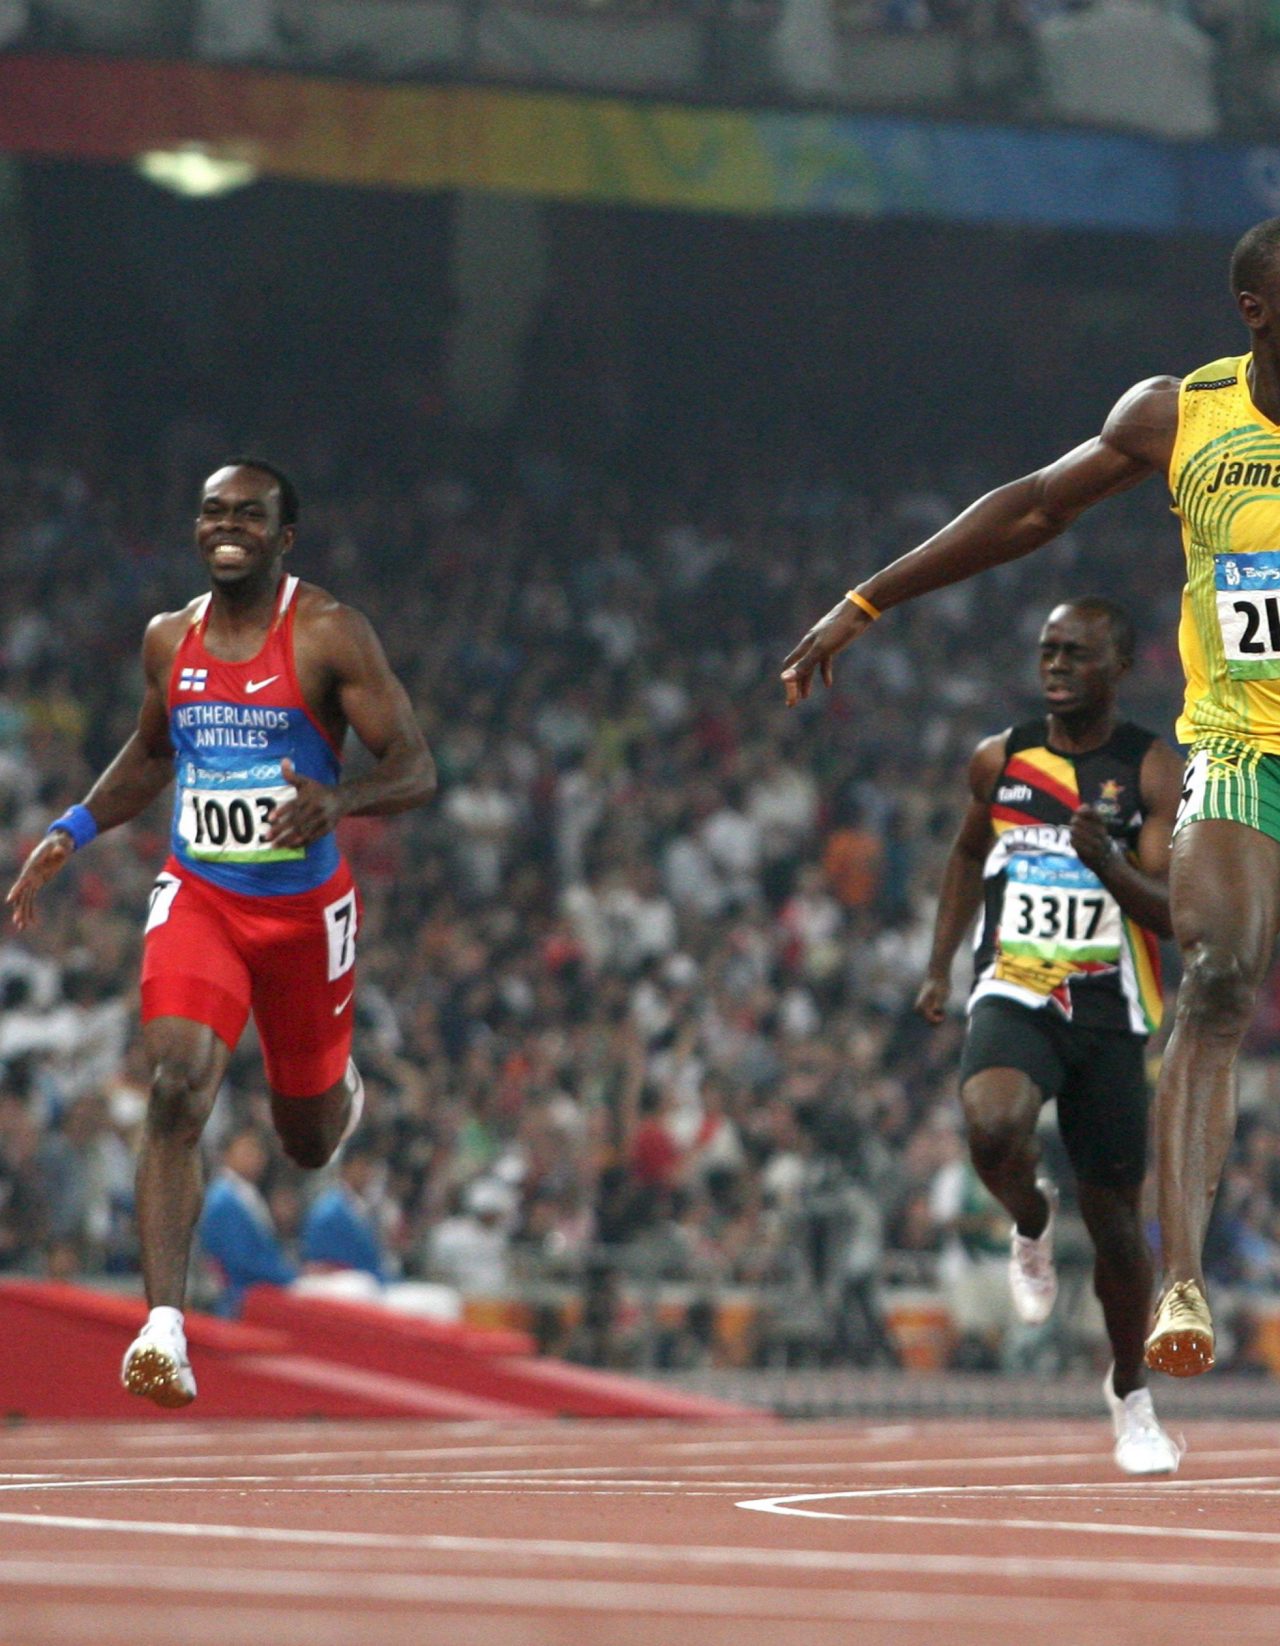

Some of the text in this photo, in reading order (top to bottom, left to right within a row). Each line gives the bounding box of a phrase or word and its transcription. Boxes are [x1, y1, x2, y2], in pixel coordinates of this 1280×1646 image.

[177, 705, 289, 729] NETHERLANDS
[196, 727, 268, 748] ANTILLES
[998, 784, 1032, 801] faith
[192, 796, 277, 845] 1003
[1017, 893, 1105, 940] 3317
[334, 902, 352, 967] 7
